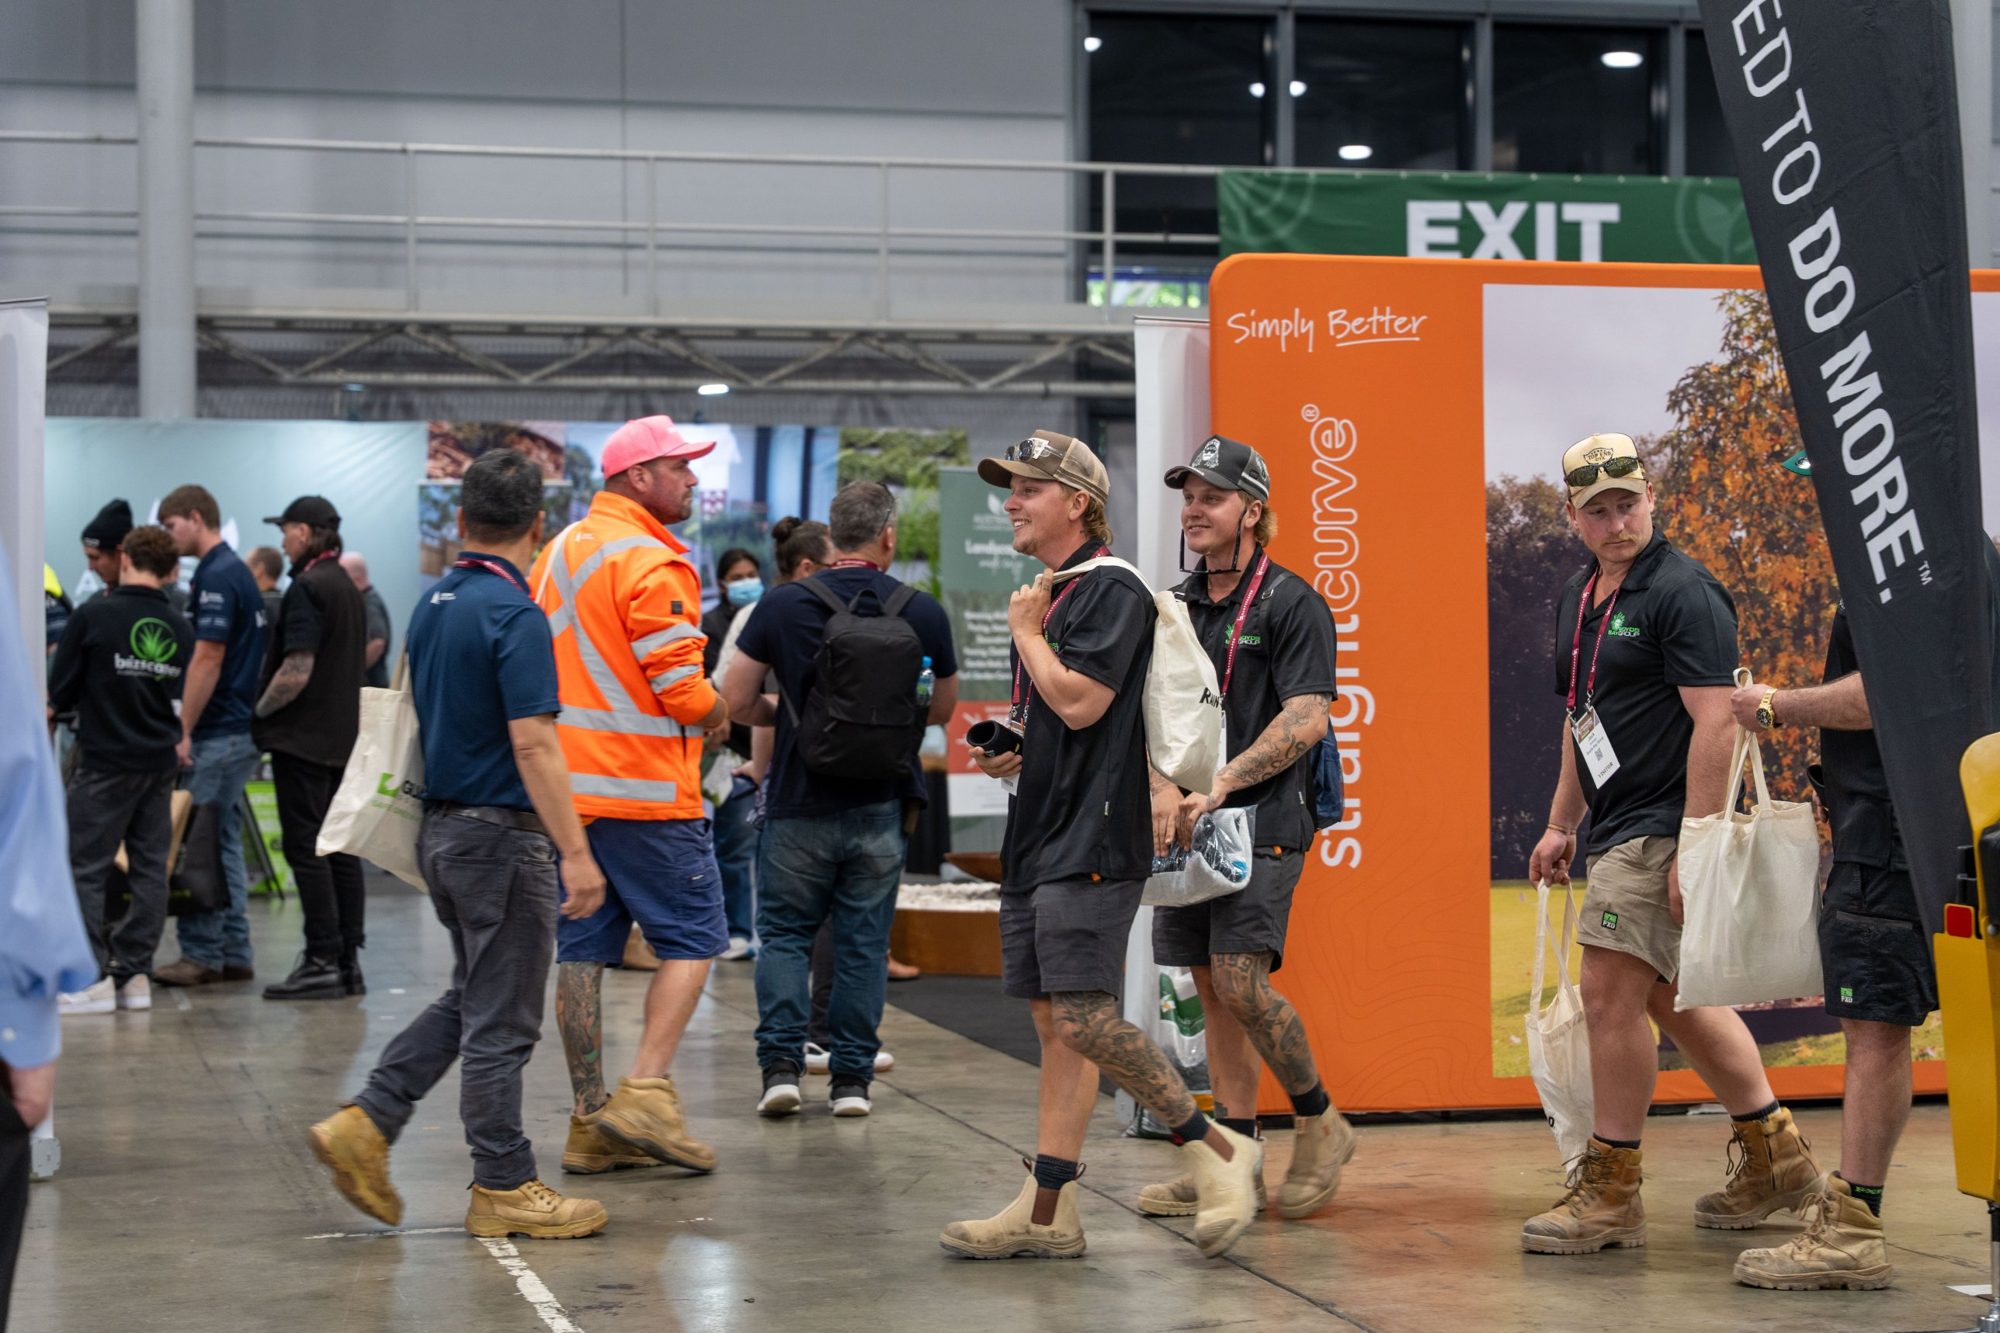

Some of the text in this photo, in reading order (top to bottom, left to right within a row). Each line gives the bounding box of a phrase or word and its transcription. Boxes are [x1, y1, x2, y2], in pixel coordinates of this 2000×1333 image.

[1732, 0, 1793, 98] ED
[1761, 87, 1822, 205] TO
[1406, 201, 1620, 263] EXIT
[1787, 206, 1857, 334] DO
[1226, 306, 1428, 352] Simply Better
